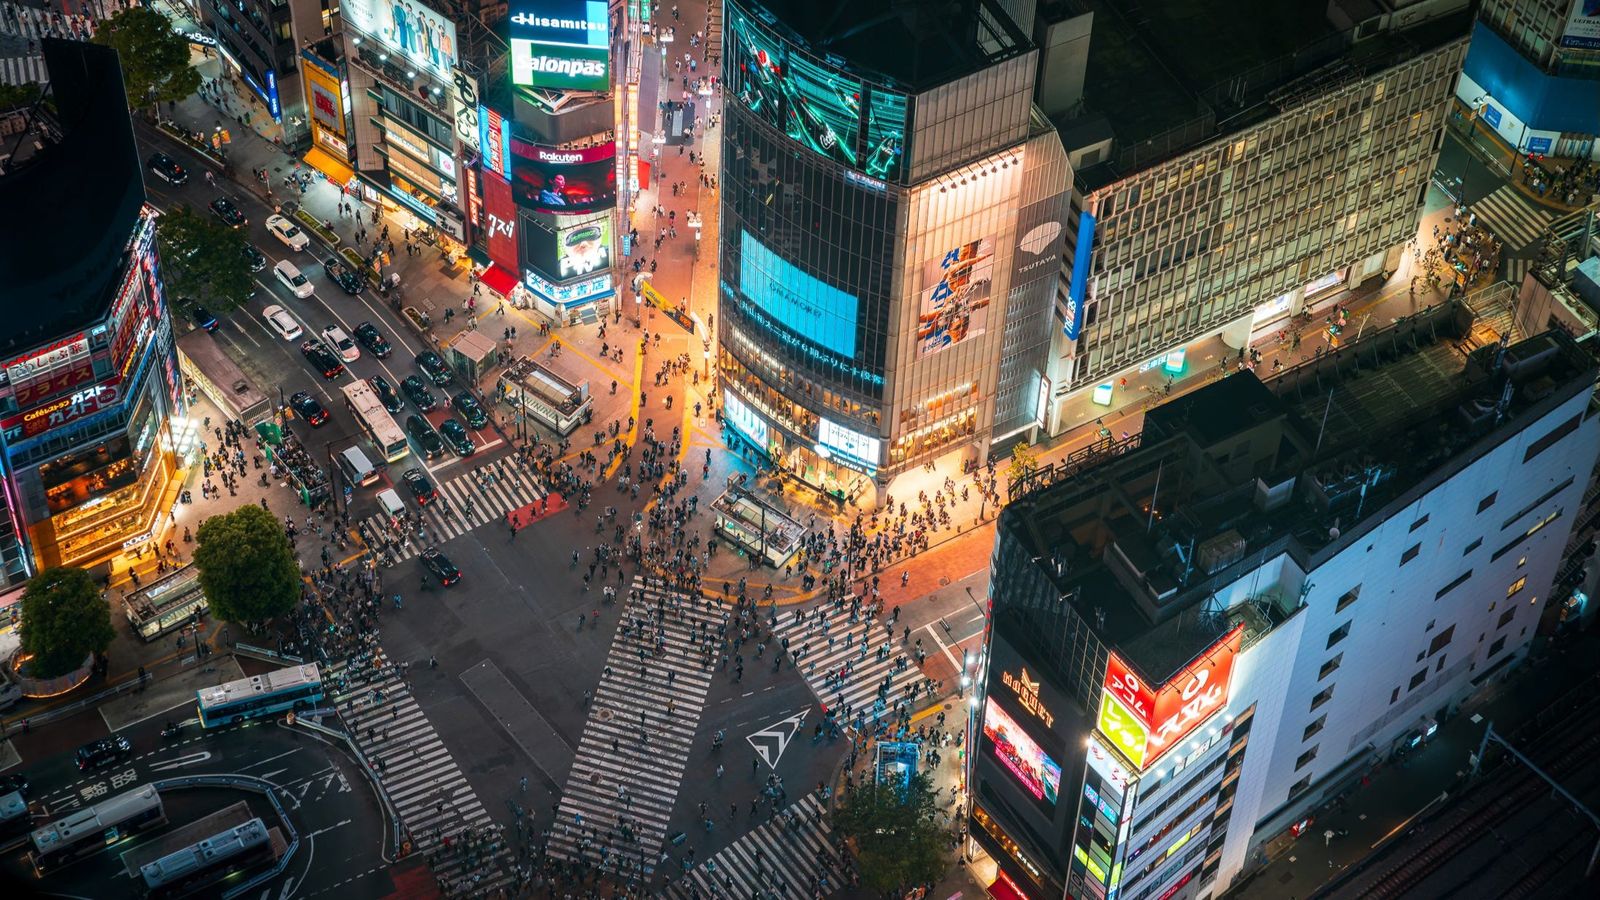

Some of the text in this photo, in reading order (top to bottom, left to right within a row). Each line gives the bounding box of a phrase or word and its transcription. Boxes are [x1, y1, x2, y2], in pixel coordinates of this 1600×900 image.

[511, 13, 607, 31] Hisamitsu
[516, 55, 606, 77] Salonpas
[539, 151, 583, 162] Rakuten
[1018, 254, 1057, 273] TSUTAYA
[71, 385, 107, 406] ガスト
[731, 378, 801, 435] STARBUCKS
[4, 426, 22, 440] 7F
[833, 456, 863, 472] TSUTAYA
[1003, 671, 1054, 729] MAGNET
[1112, 674, 1147, 719] アコム
